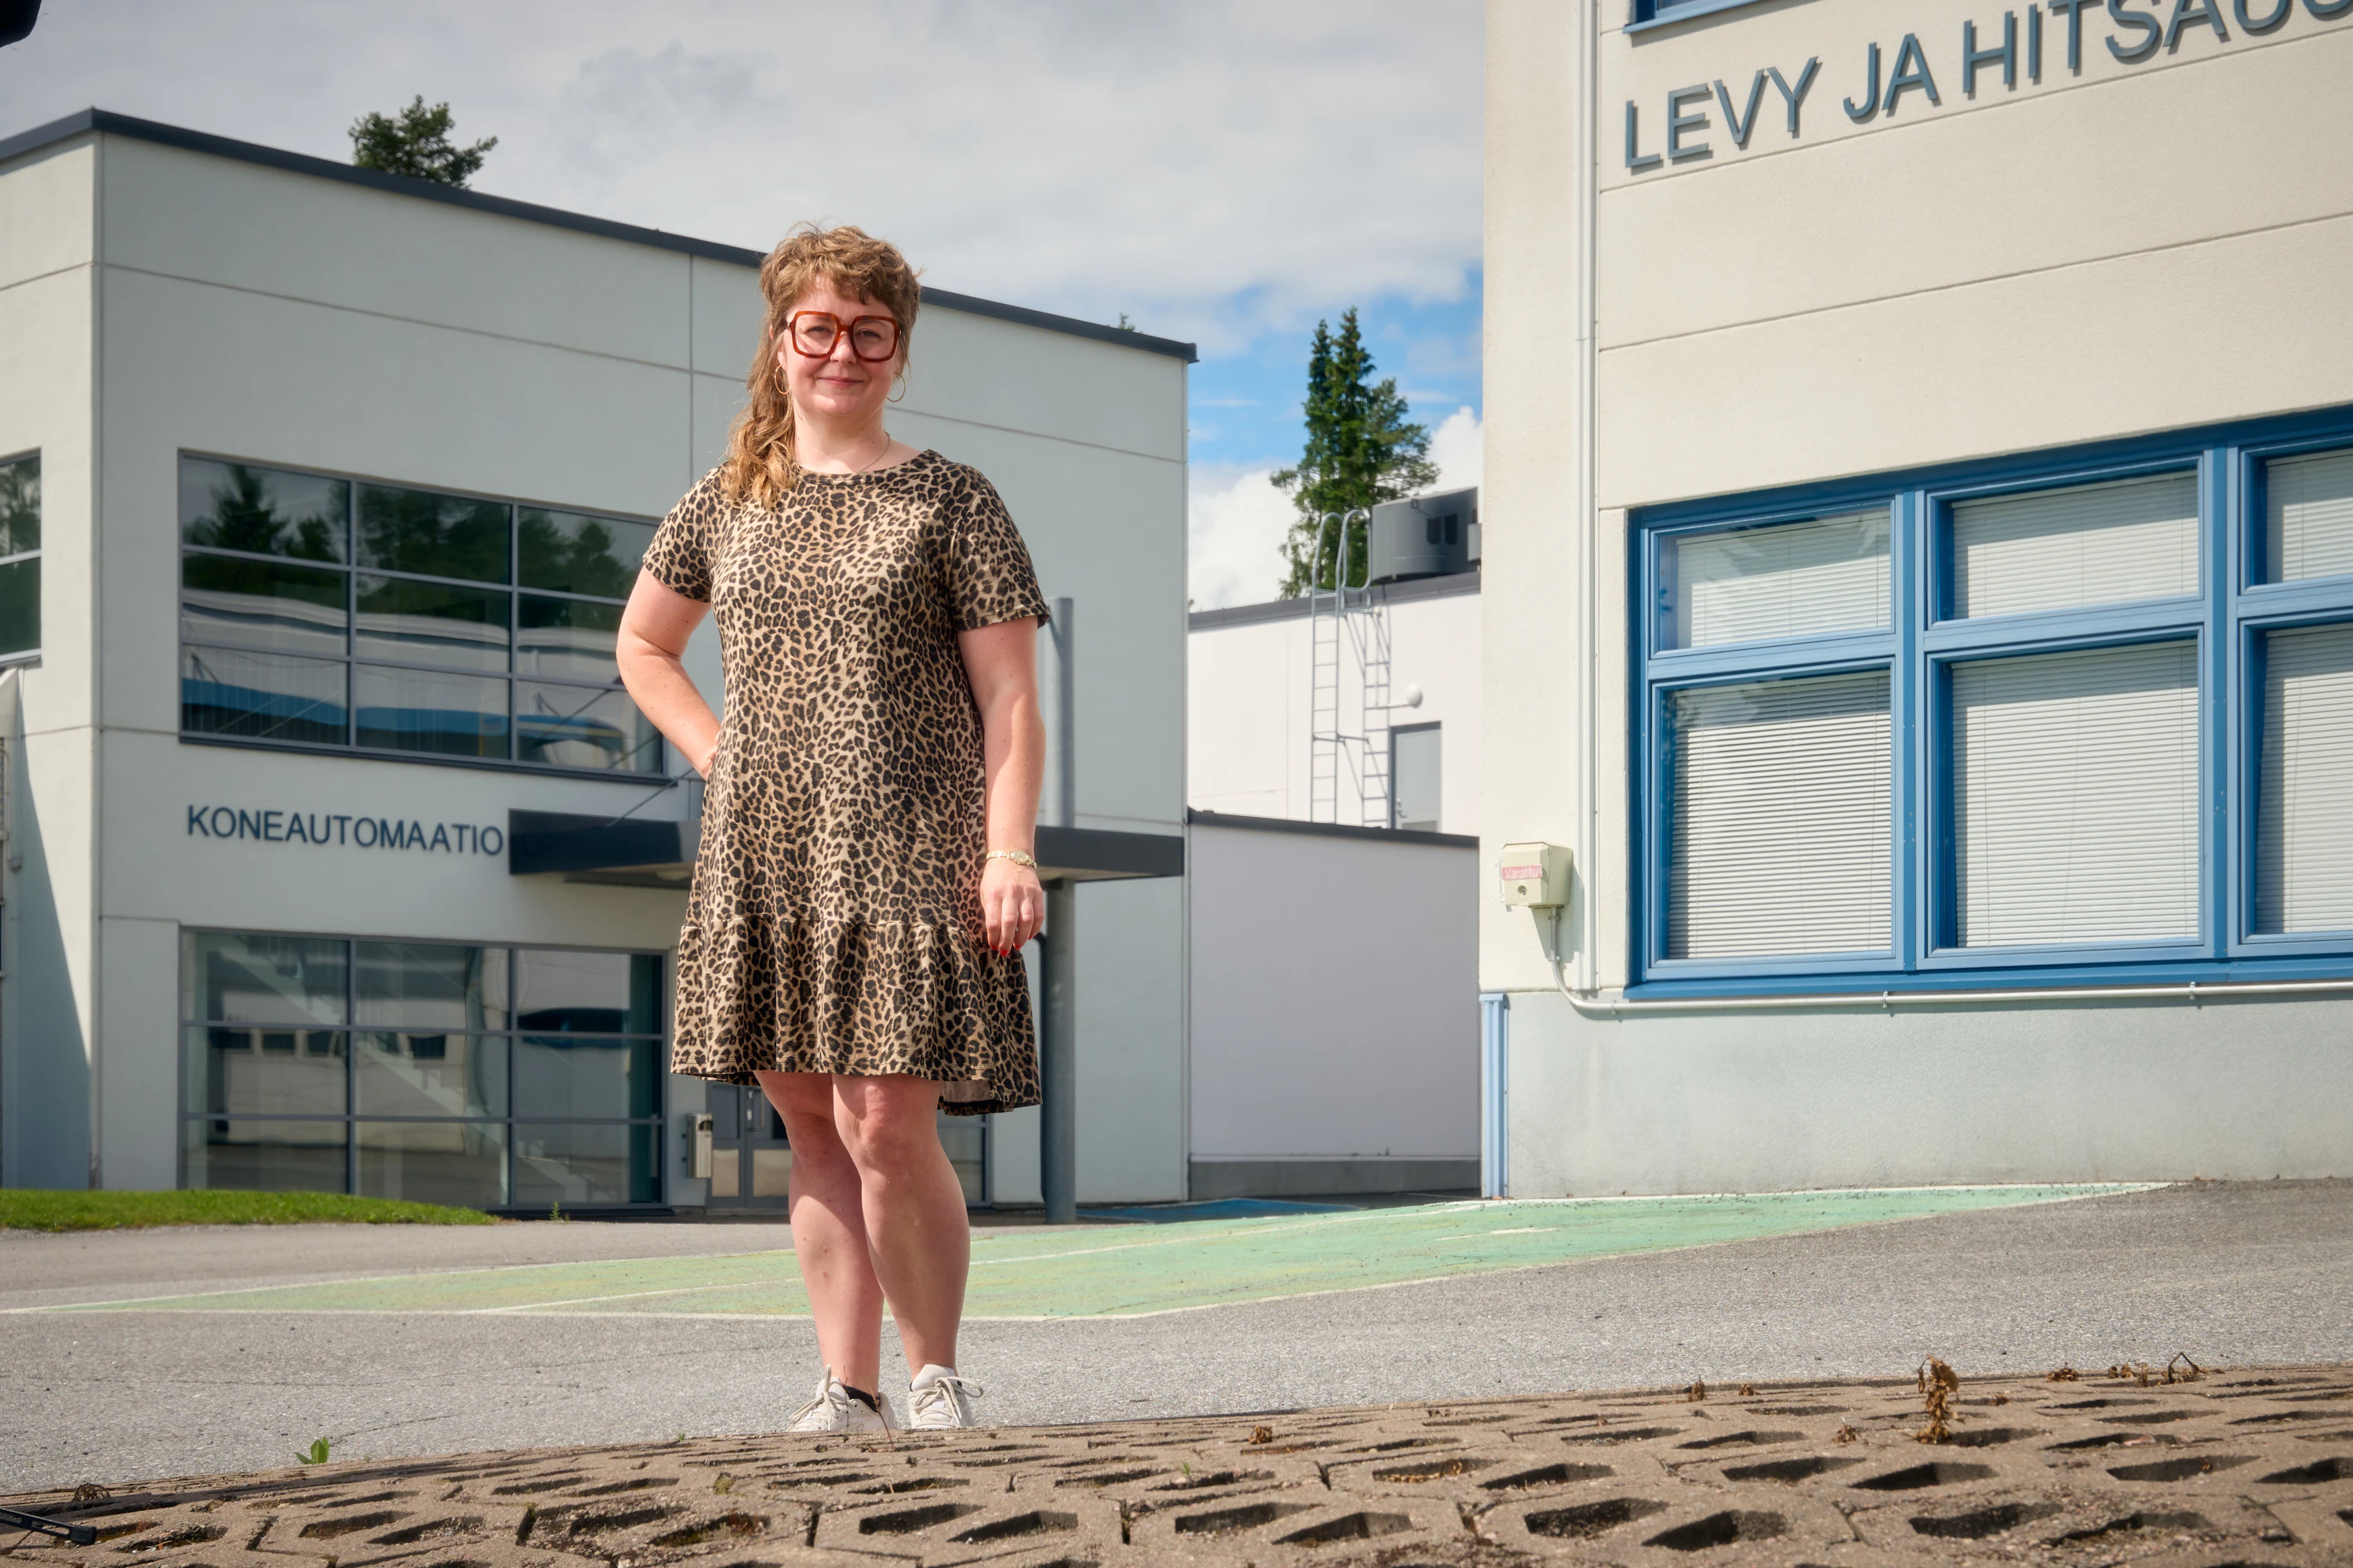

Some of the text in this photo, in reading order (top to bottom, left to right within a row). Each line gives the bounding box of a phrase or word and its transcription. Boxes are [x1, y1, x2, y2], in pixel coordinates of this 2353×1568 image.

[1625, 0, 2353, 168] LEVY JA HITSA
[188, 805, 503, 856] KONEAUTOMAATIO
[1505, 866, 1539, 878] Varattu
